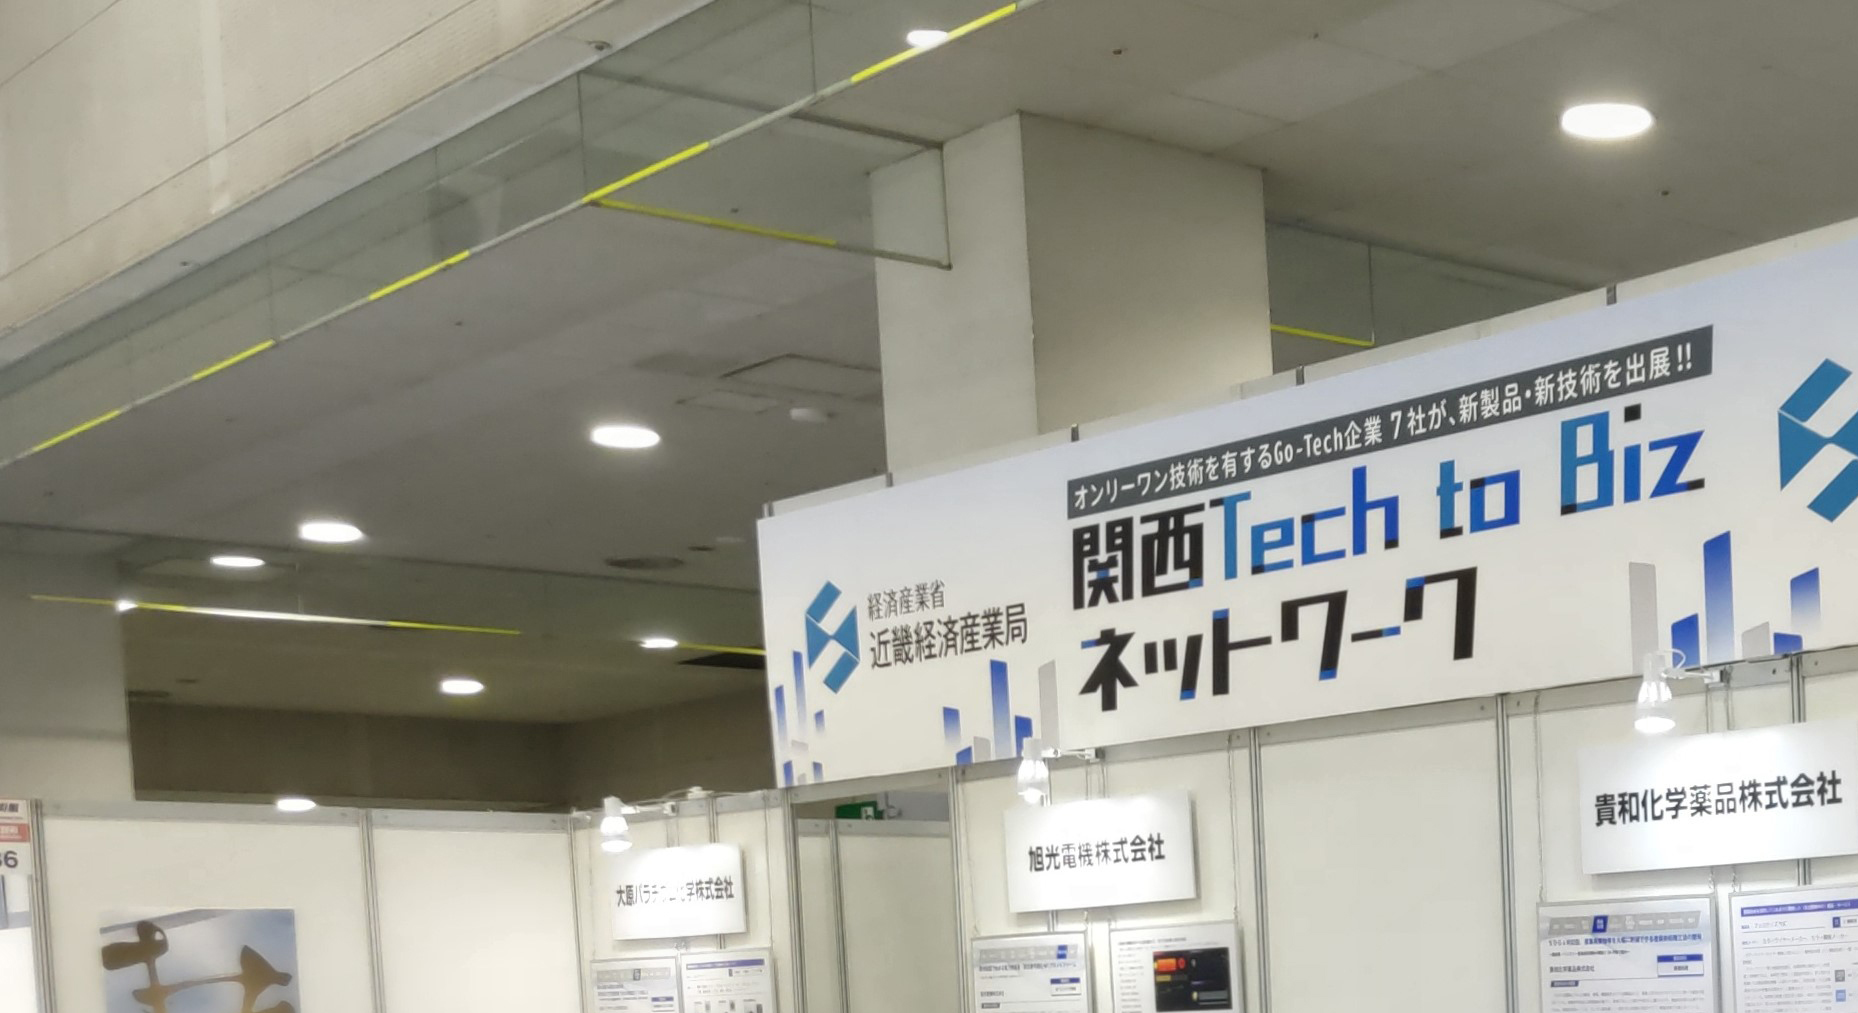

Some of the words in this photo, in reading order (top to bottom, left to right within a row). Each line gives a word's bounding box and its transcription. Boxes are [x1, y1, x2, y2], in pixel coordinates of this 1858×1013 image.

[1072, 465, 1399, 610] 関西Tech
[1436, 459, 1520, 539] to
[1560, 403, 1705, 516] Biz
[866, 579, 945, 620] 経済産業省
[869, 603, 1028, 670] 近畿経済産業局
[1079, 566, 1478, 712] ネットワーク
[1594, 770, 1843, 827] 貴和化学薬品株式会社
[0, 850, 18, 869] 6
[1028, 832, 1166, 873] 旭光電機株式会社
